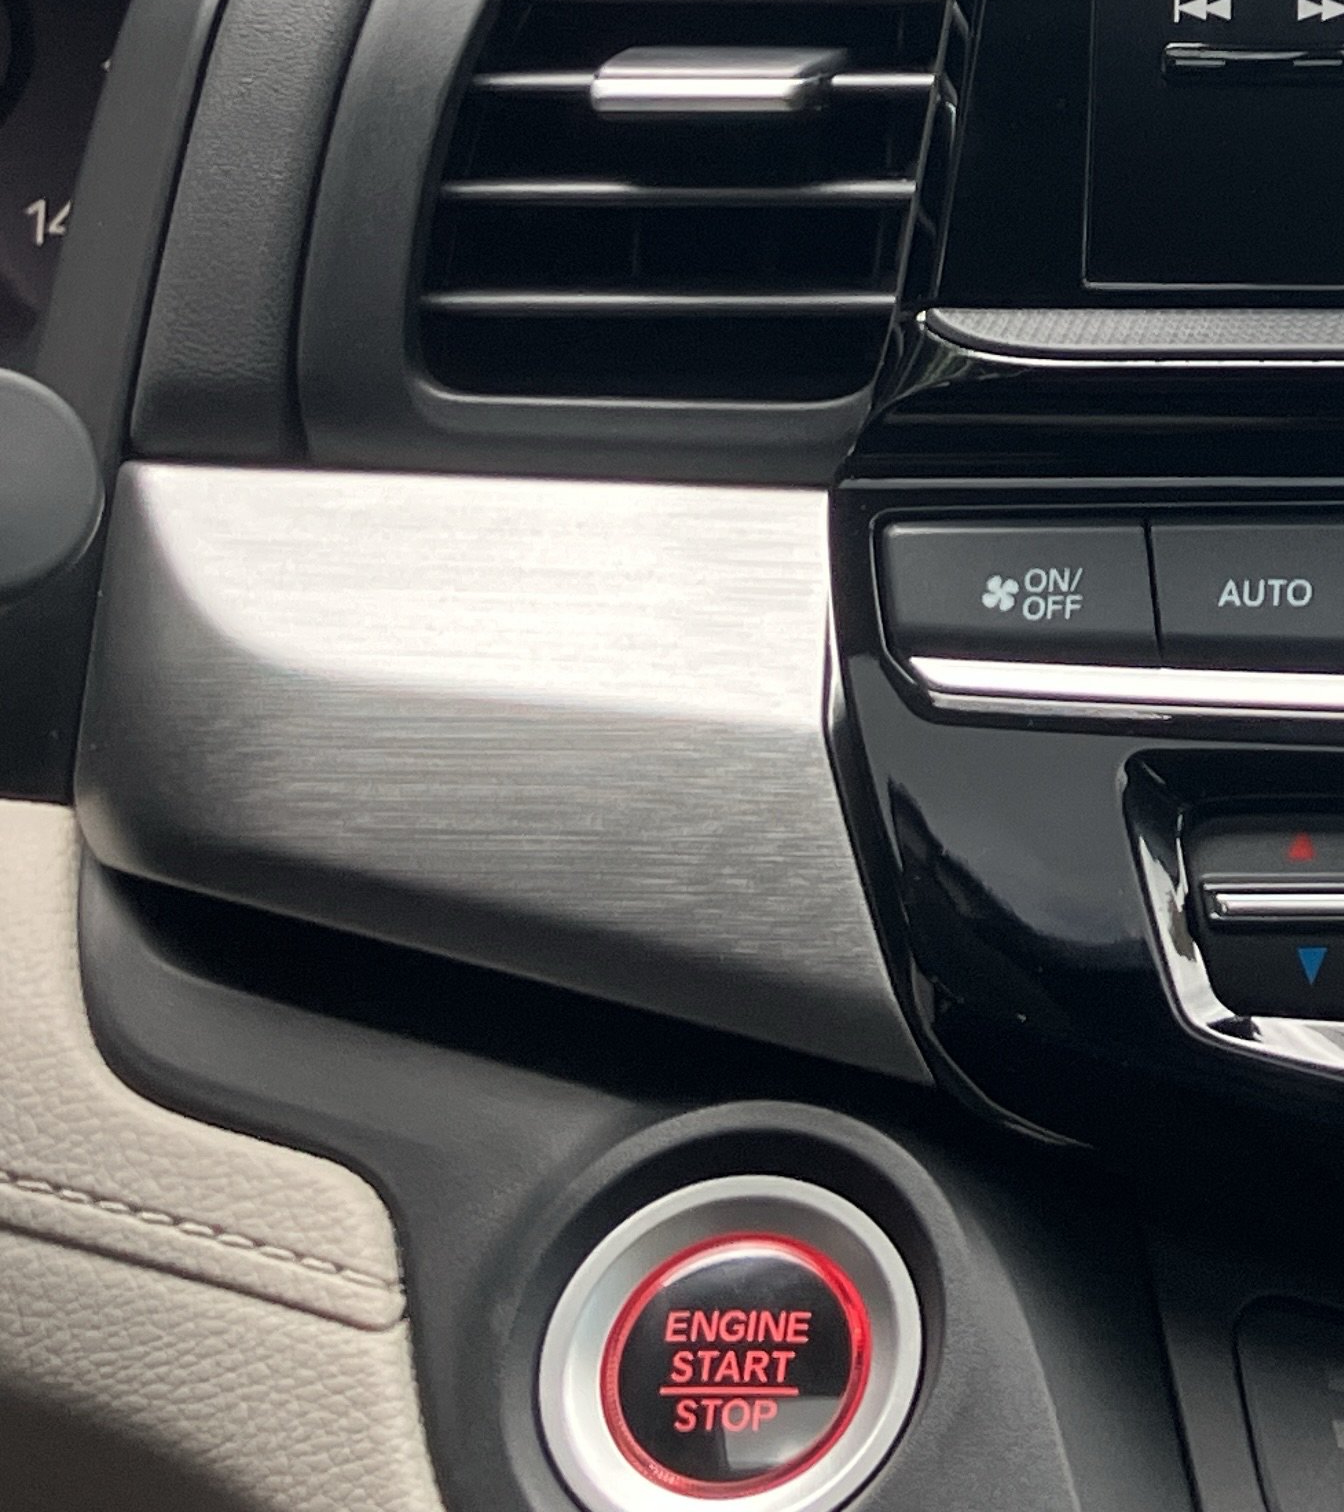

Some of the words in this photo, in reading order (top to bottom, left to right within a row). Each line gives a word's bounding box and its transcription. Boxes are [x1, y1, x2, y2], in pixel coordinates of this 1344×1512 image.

[1023, 567, 1084, 594] ON/
[1217, 578, 1313, 608] AUTO
[1021, 593, 1084, 622] OFF
[665, 1310, 812, 1343] ENGINE
[670, 1349, 796, 1384] START
[674, 1399, 778, 1432] STOP
